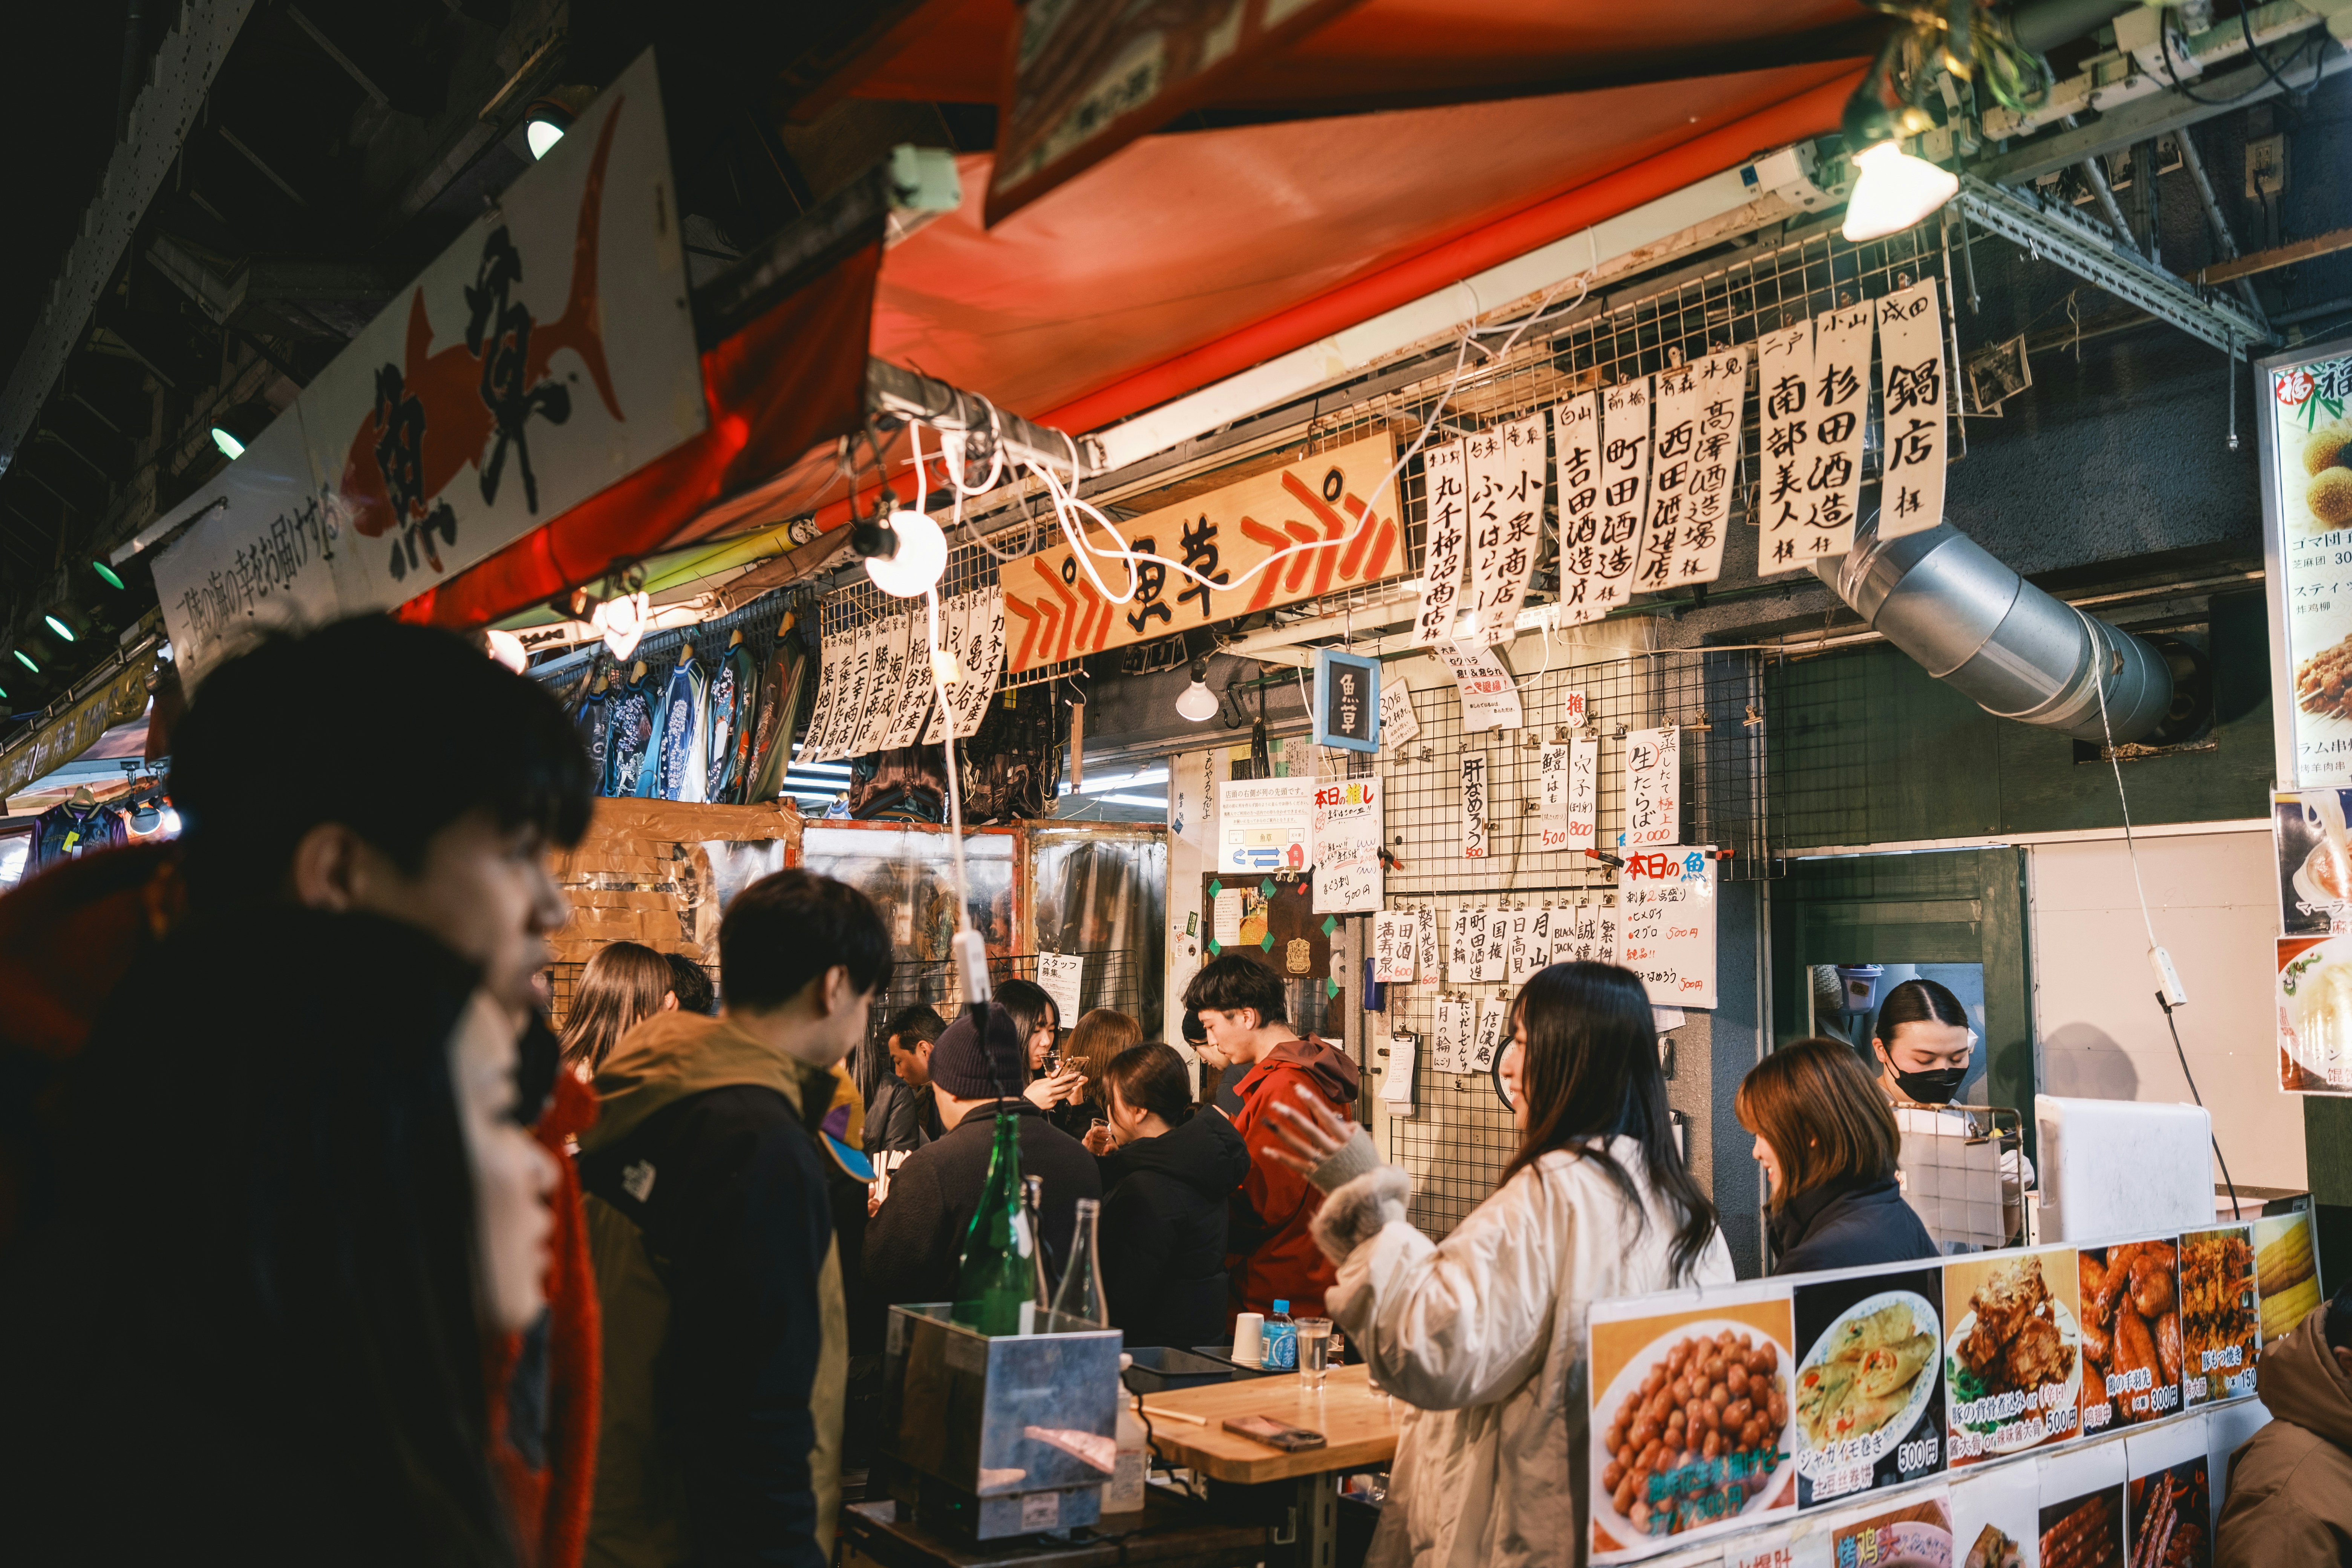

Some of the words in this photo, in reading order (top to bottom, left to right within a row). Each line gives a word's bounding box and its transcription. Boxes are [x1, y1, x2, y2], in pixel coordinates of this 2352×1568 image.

[1824, 313, 1868, 332] 小山
[1764, 331, 1804, 356] 二戸
[1560, 406, 1592, 426] 白山
[1124, 516, 1229, 632] 魚草
[1340, 674, 1359, 733] 魚草
[1574, 755, 1591, 796] 穴子
[2300, 761, 2345, 773] 烤羊肉串
[1225, 787, 1304, 799] 店頭の右側が列の先頭です。
[1314, 783, 1374, 809] 本日の推し
[1462, 758, 1484, 849] 肝なめろう
[1260, 833, 1272, 842] 魚草
[1542, 829, 1565, 845] 500
[1570, 821, 1592, 836] 800
[1465, 847, 1483, 858] 500
[1624, 851, 1707, 883] 本日の魚
[1345, 884, 1370, 905] 500円
[1633, 908, 1662, 922] ヒメダイ
[2298, 900, 2352, 914] マーラ
[1633, 925, 1657, 939] マグロ
[1666, 927, 1698, 939] 500円
[2333, 920, 2352, 934] 麻
[1376, 921, 1394, 974] 満寿泉
[1396, 923, 1413, 960] 田酒
[1453, 916, 1467, 964] 月の輪
[1470, 914, 1487, 980] 町田酒造
[1487, 920, 1507, 959] 国権
[1512, 917, 1526, 973] 日高見
[1529, 912, 1549, 968] 月山
[1554, 942, 1573, 954] JACK
[1574, 919, 1595, 961] 誠鏡
[1043, 958, 1076, 969] スタッフ
[1395, 966, 1412, 976] 600
[1422, 974, 1438, 985] 600
[1678, 978, 1703, 991] 500円
[1436, 1006, 1451, 1053] 月の輪
[1434, 1057, 1450, 1068] にごり
[2202, 1347, 2242, 1371] 豚もつ焼き
[2107, 1370, 2151, 1395] 鶏の手羽先
[1952, 1391, 2025, 1425] 豚の背骨煮込み
[2152, 1387, 2177, 1410] 300円
[2047, 1408, 2076, 1433] 500円
[2085, 1405, 2111, 1425] 鸡翅中
[1800, 1434, 1882, 1471] ジャガイモ巻き
[1900, 1441, 1937, 1470] 500円
